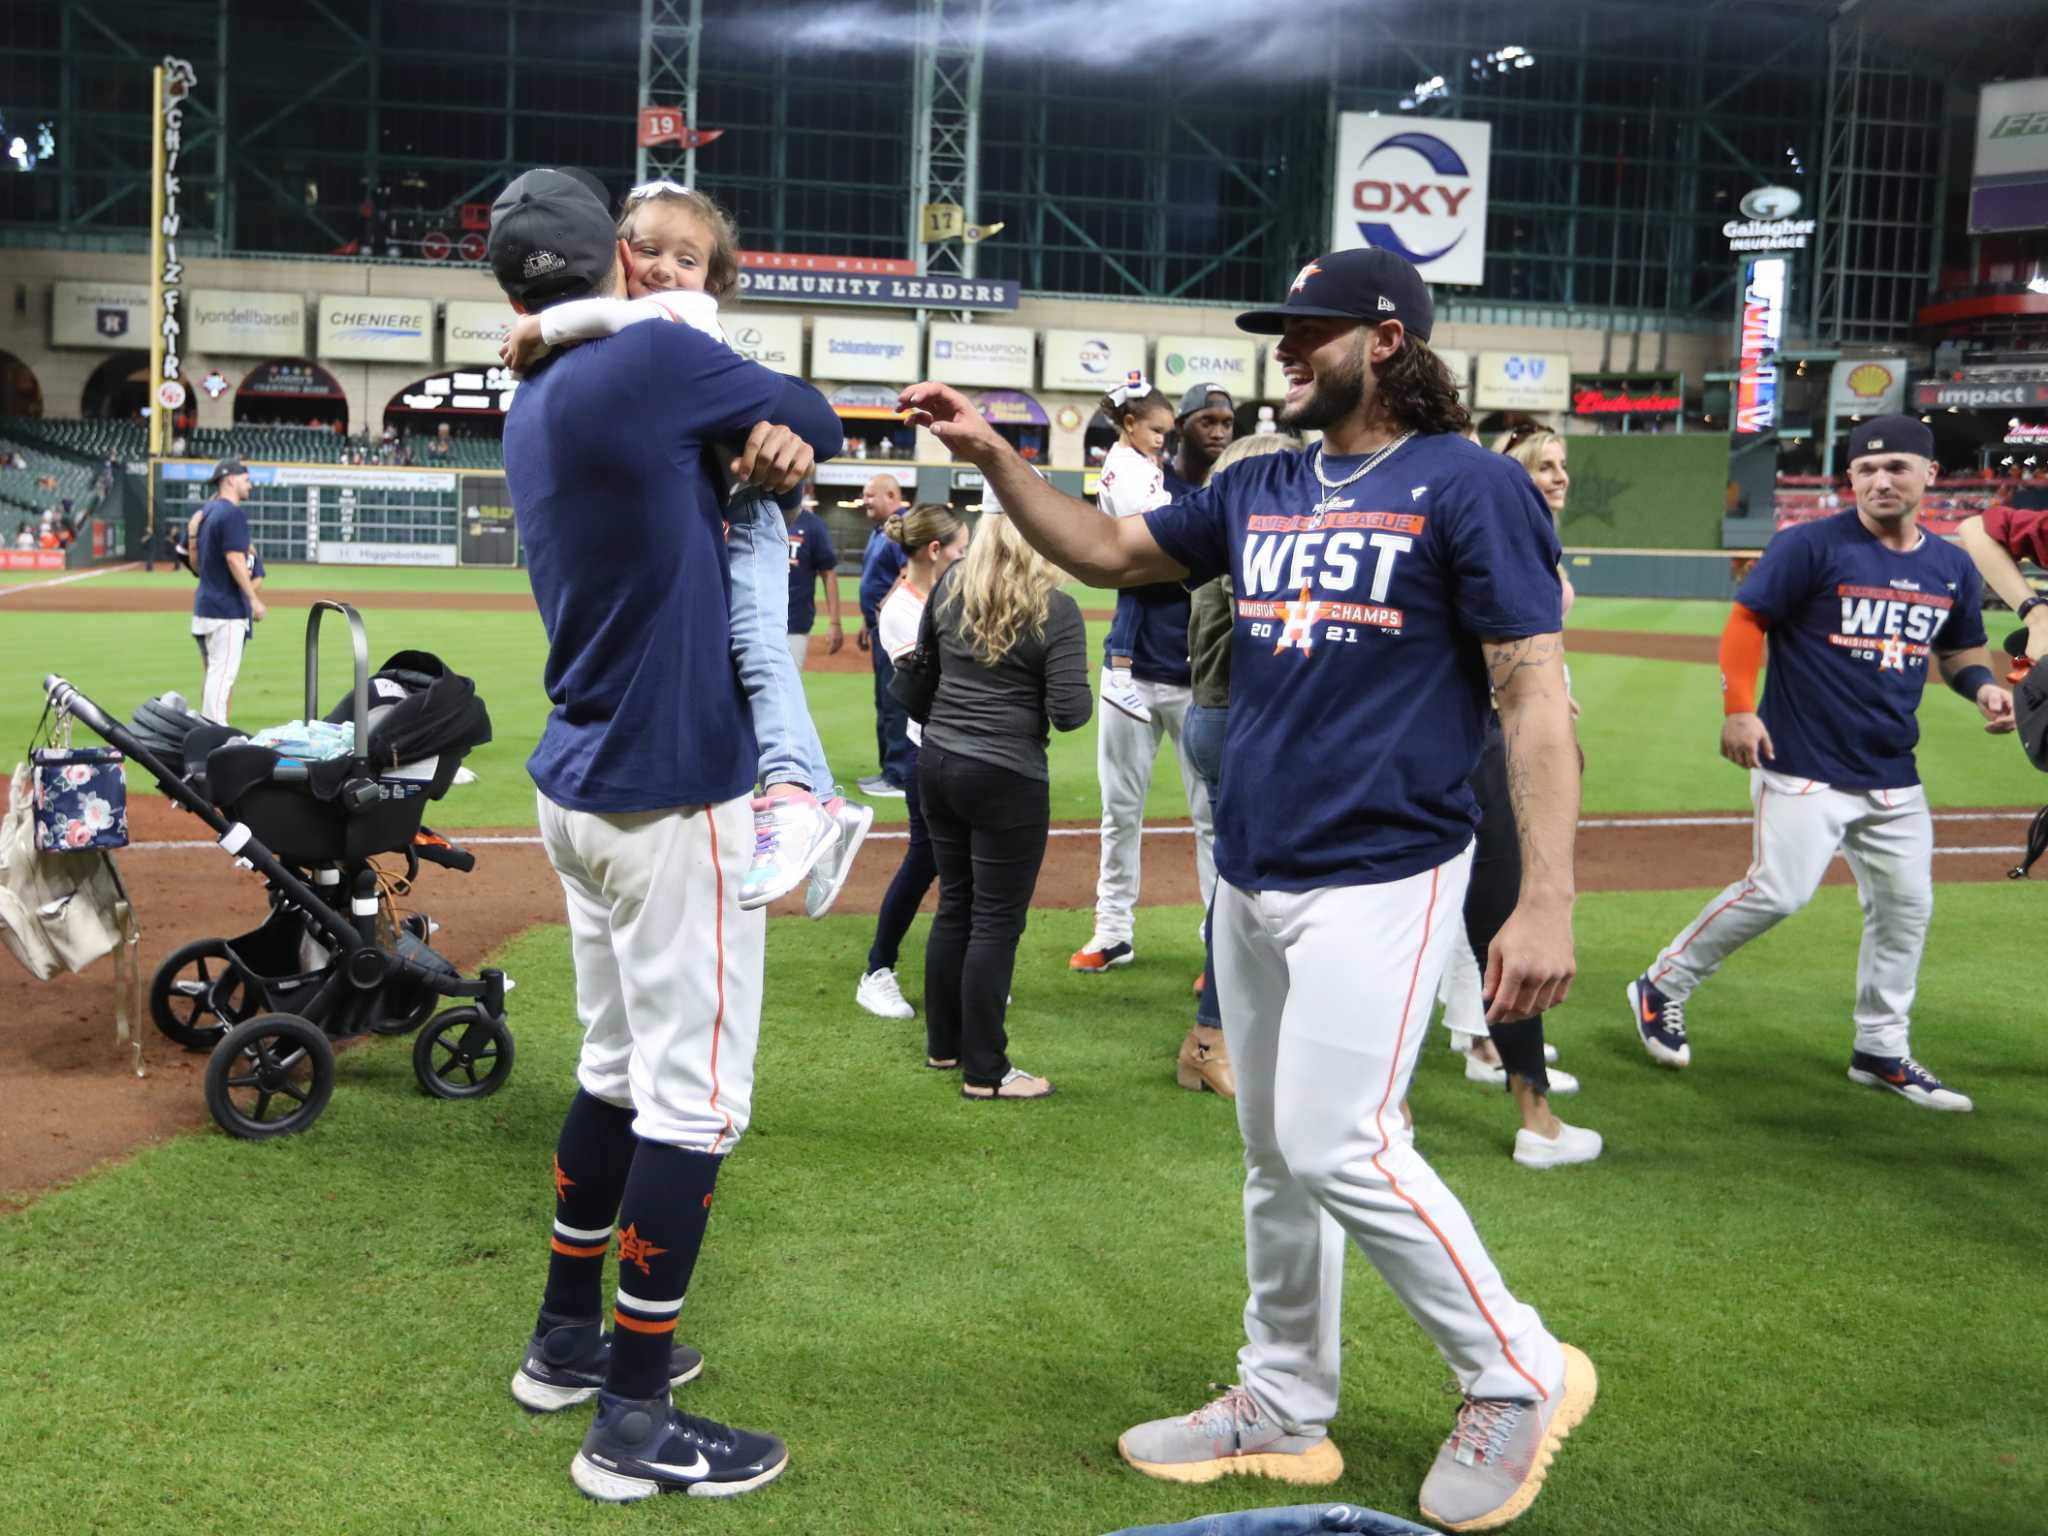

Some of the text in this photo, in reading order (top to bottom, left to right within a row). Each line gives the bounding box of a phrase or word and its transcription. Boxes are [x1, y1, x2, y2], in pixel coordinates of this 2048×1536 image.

[649, 115, 674, 136] 19
[162, 108, 183, 237] CHIKIN
[1353, 180, 1472, 217] OXY
[931, 212, 953, 230] 17
[1722, 219, 1817, 238] Gallagher
[1729, 235, 1808, 251] INSURANCE
[737, 272, 1005, 303] OMMUNITY LEADERS
[329, 311, 424, 329] CHENIERE
[162, 290, 180, 380] FAIR
[451, 326, 508, 341] Conoco
[954, 341, 1028, 356] CHAMPION
[1188, 356, 1244, 372] CRANE
[1936, 386, 2025, 406] impact
[1242, 531, 1413, 604] WEST
[1238, 601, 1399, 626] DIVISION CHAMPS
[1840, 596, 1950, 644] WEST
[1251, 622, 1273, 638] 20
[1325, 625, 1358, 643] 21
